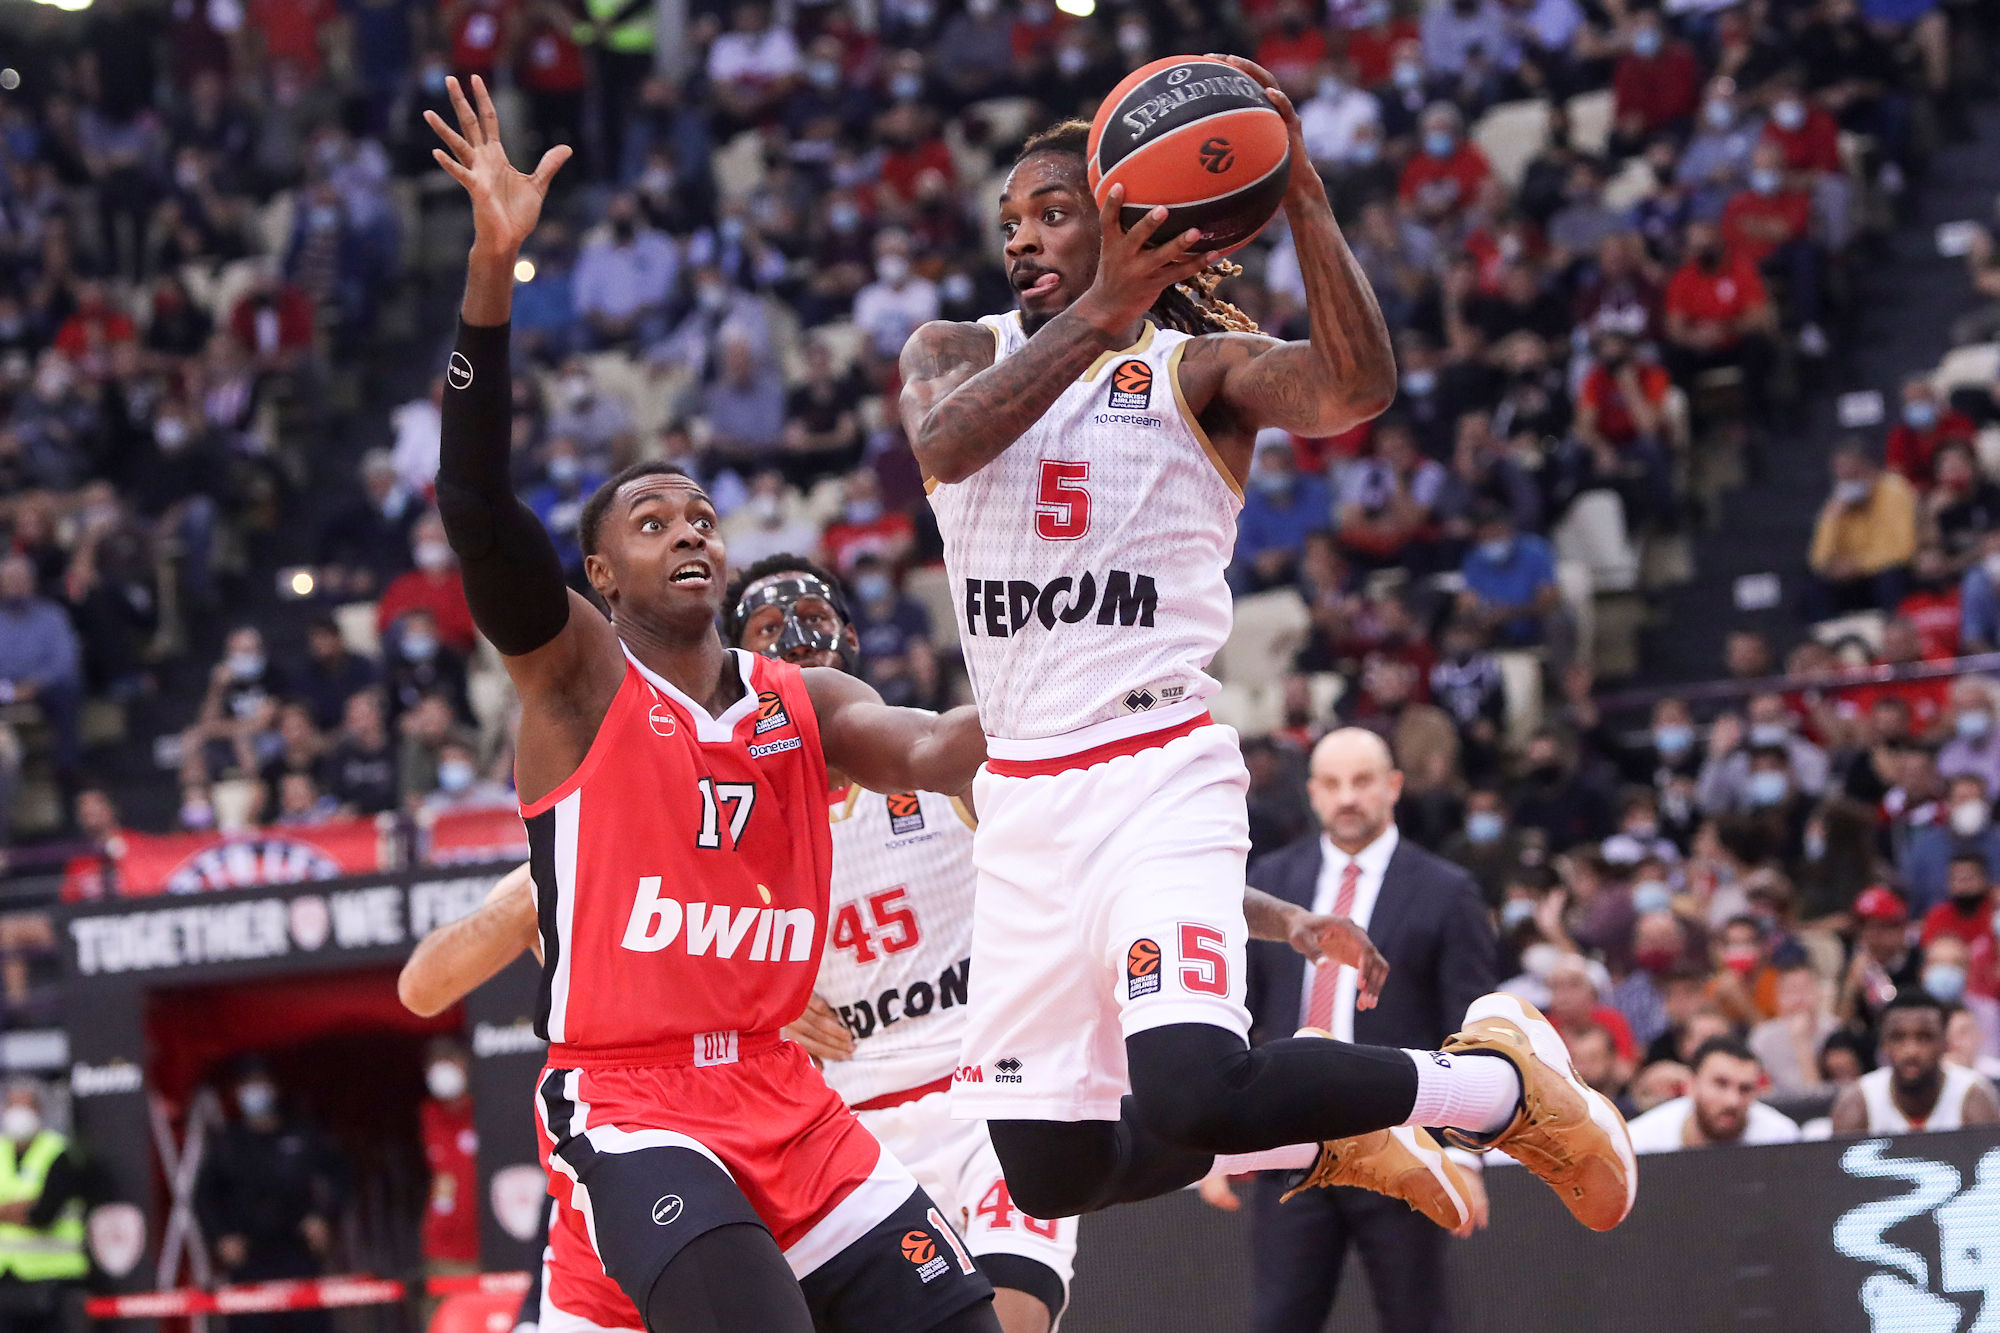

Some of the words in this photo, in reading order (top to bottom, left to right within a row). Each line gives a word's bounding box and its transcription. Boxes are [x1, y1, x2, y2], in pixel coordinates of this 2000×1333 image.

[1122, 76, 1258, 140] SPALDING
[1113, 392, 1148, 400] TURKISH
[1035, 459, 1091, 541] 5
[966, 569, 1158, 638] FEDCOM
[1161, 686, 1184, 697] SIZE
[696, 776, 757, 851] 17
[69, 897, 288, 976] TOGETHER
[331, 886, 404, 947] WE
[621, 876, 816, 962] bwin
[831, 883, 923, 967] 45
[1130, 973, 1158, 986] TURKISH
[1130, 979, 1158, 992] AIRLINES
[1177, 921, 1230, 999] 5
[704, 1031, 730, 1061] OLY
[916, 1255, 944, 1274] TURKISH
[919, 1260, 947, 1279] AIRLINES
